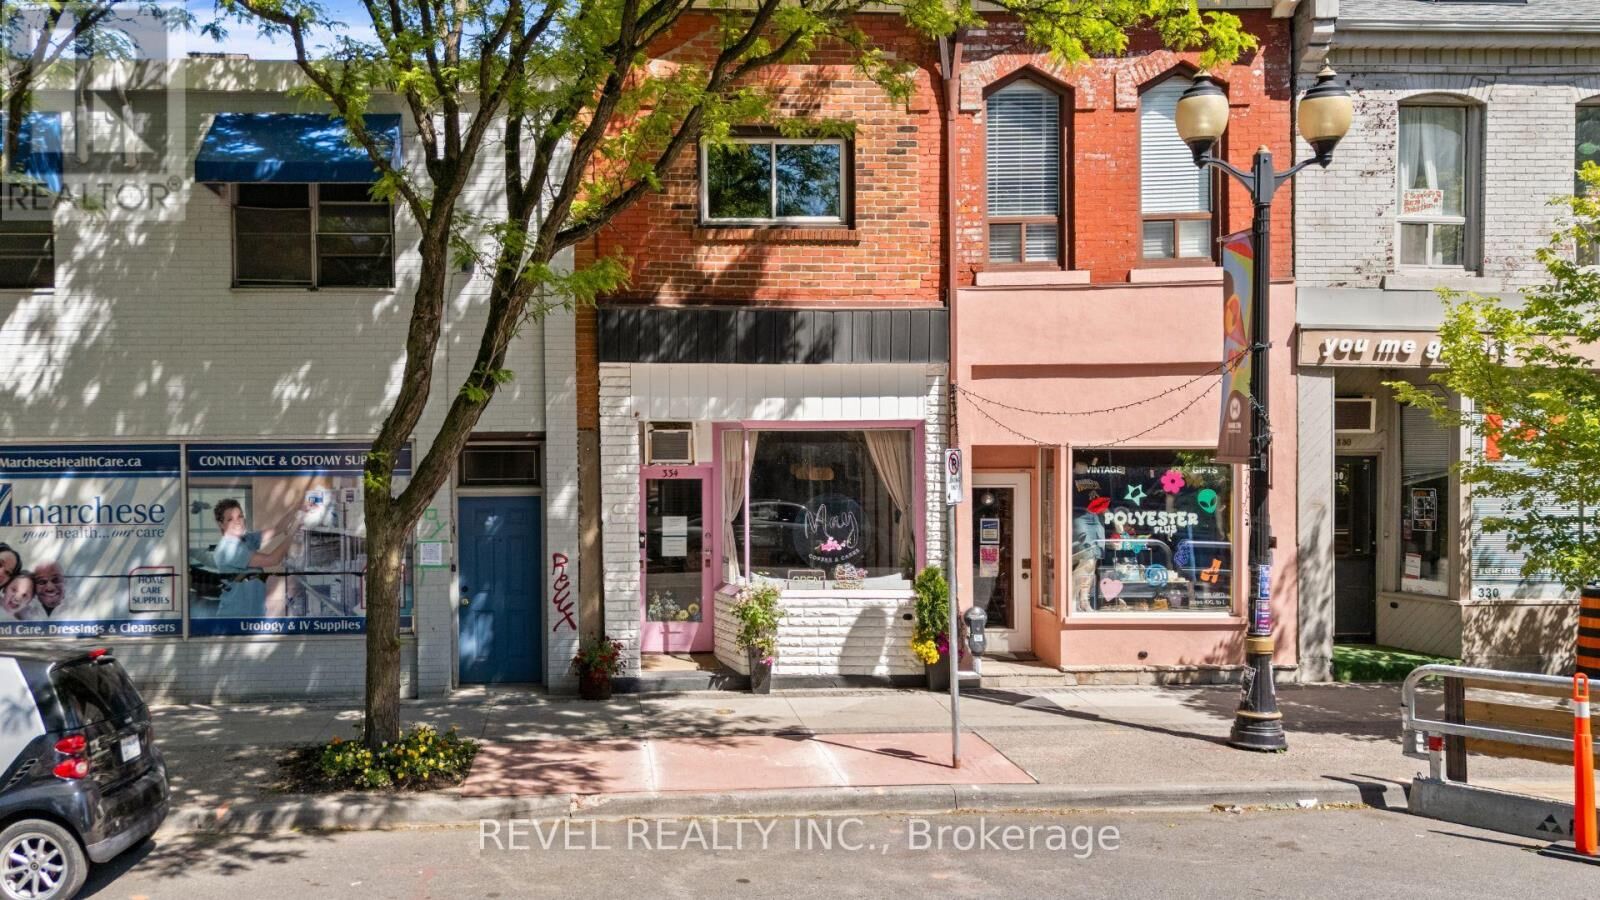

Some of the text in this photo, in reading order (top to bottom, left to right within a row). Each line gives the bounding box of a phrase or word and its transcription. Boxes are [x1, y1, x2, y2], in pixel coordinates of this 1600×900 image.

[1322, 338, 1370, 357] you
[1378, 339, 1417, 354] me
[199, 455, 275, 466] CONTINENCE
[279, 456, 287, 466] &
[291, 455, 341, 466] OSTOMY
[1086, 466, 1218, 474] VINTAGE GIFTS
[15, 496, 166, 524] marchese
[1104, 510, 1199, 527] POLYESTER
[136, 528, 165, 538] care
[1153, 524, 1178, 536] PLUS
[140, 586, 161, 594] CARE
[1478, 587, 1499, 598] 330
[15, 625, 45, 636] Care,
[49, 624, 104, 636] Dressings
[109, 625, 116, 633] &
[120, 622, 176, 633] Cleansers
[240, 619, 361, 632] Urology & IV Supplies
